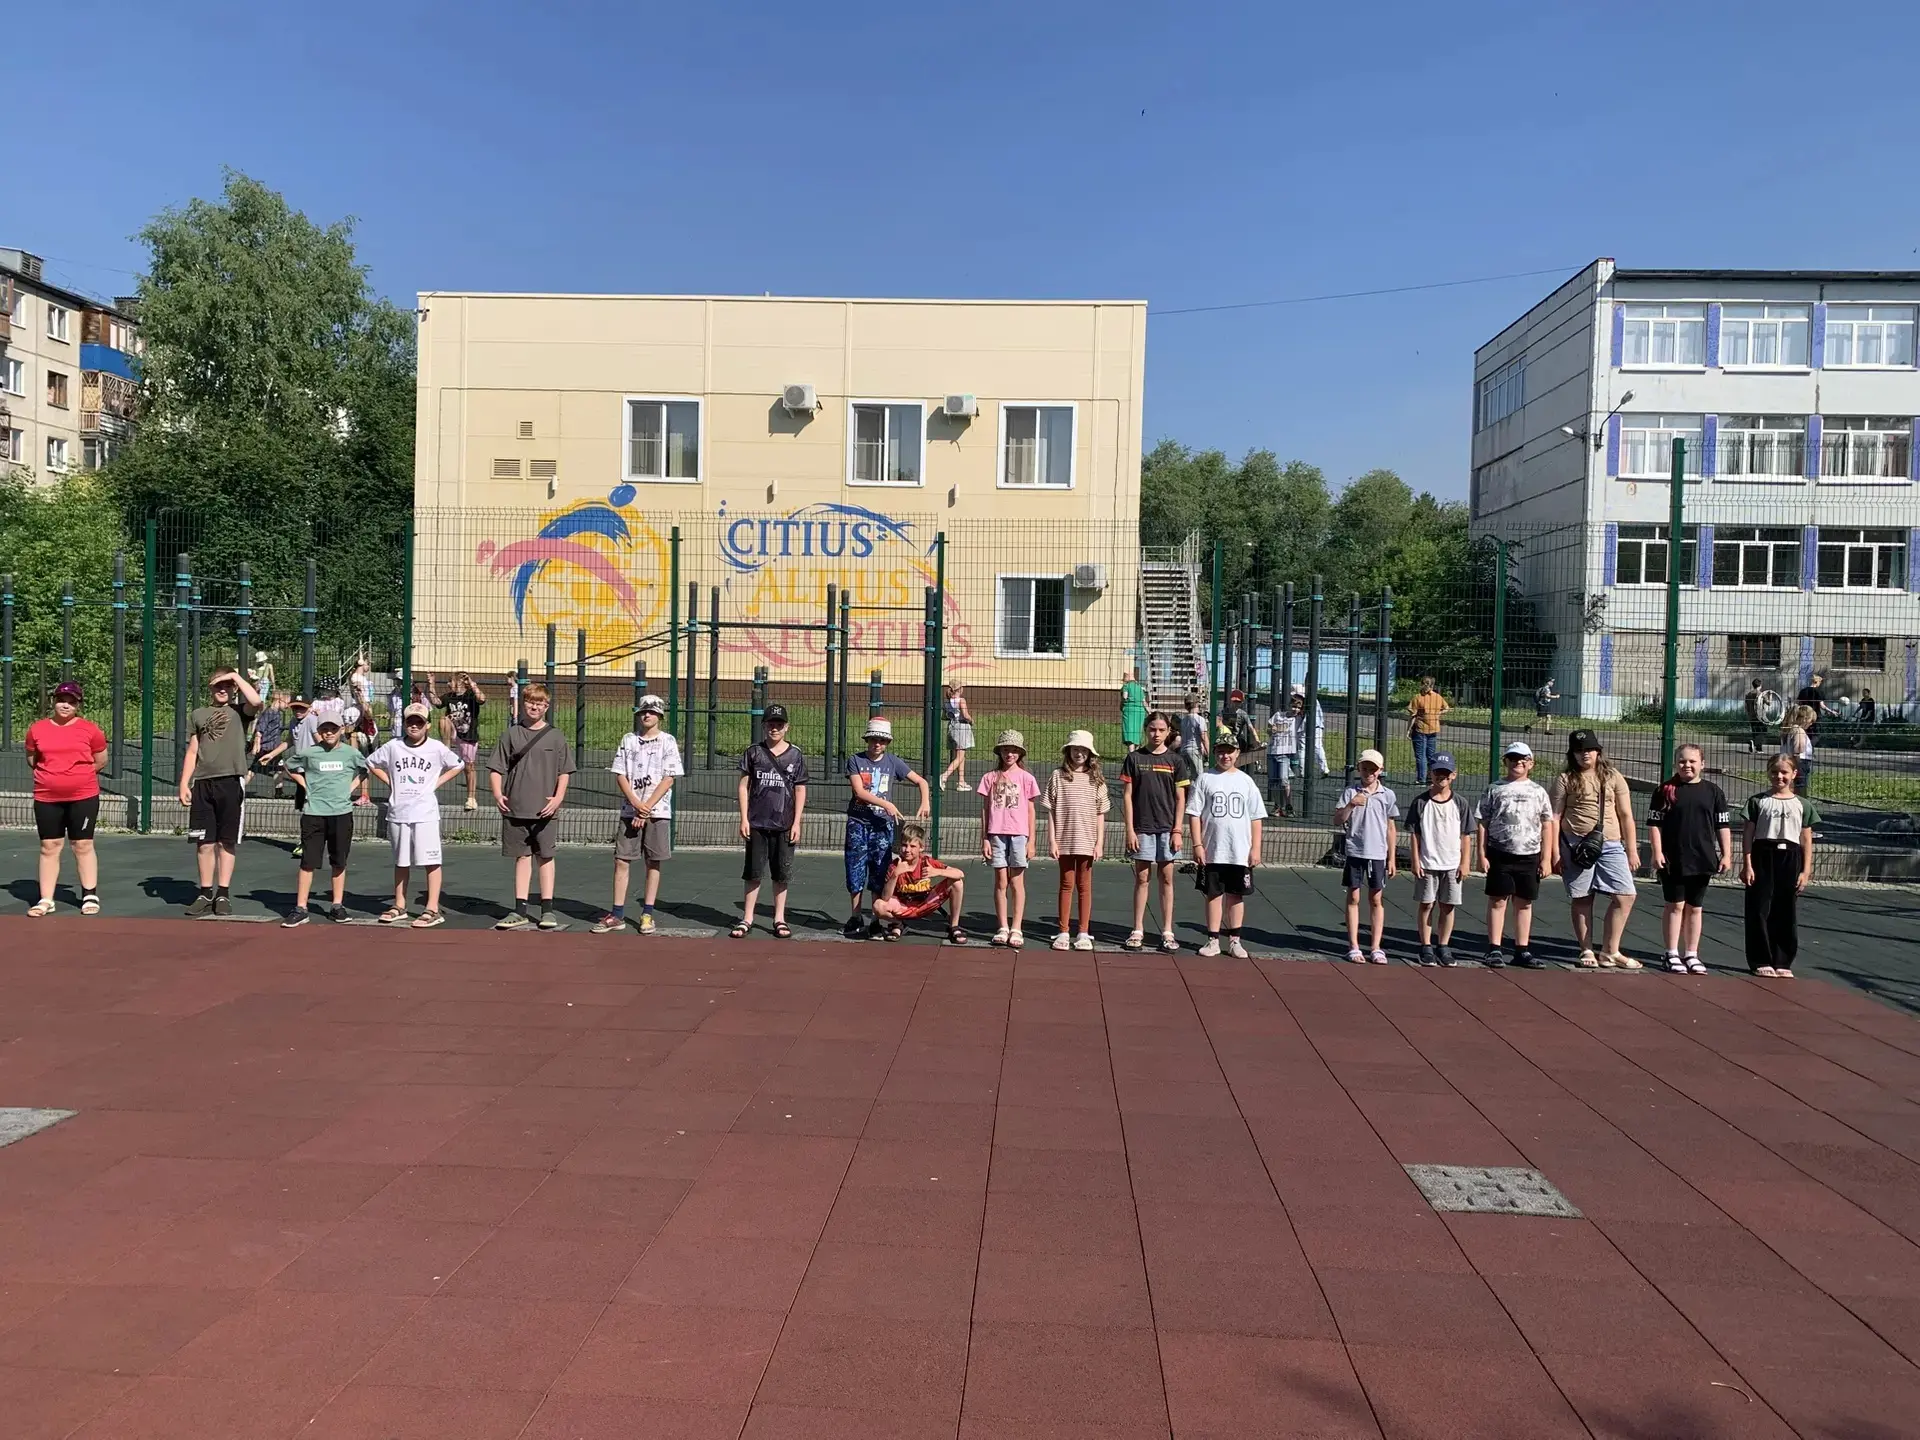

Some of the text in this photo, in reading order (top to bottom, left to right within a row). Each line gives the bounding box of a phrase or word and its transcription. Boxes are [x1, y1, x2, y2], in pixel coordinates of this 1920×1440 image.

[727, 518, 874, 558] CITIUS
[748, 567, 910, 609] ALTIUS
[779, 618, 975, 659] FORTIS
[395, 757, 432, 772] SHARP
[756, 770, 783, 780] Emira
[399, 775, 425, 784] 19 99
[1211, 791, 1245, 818] 80
